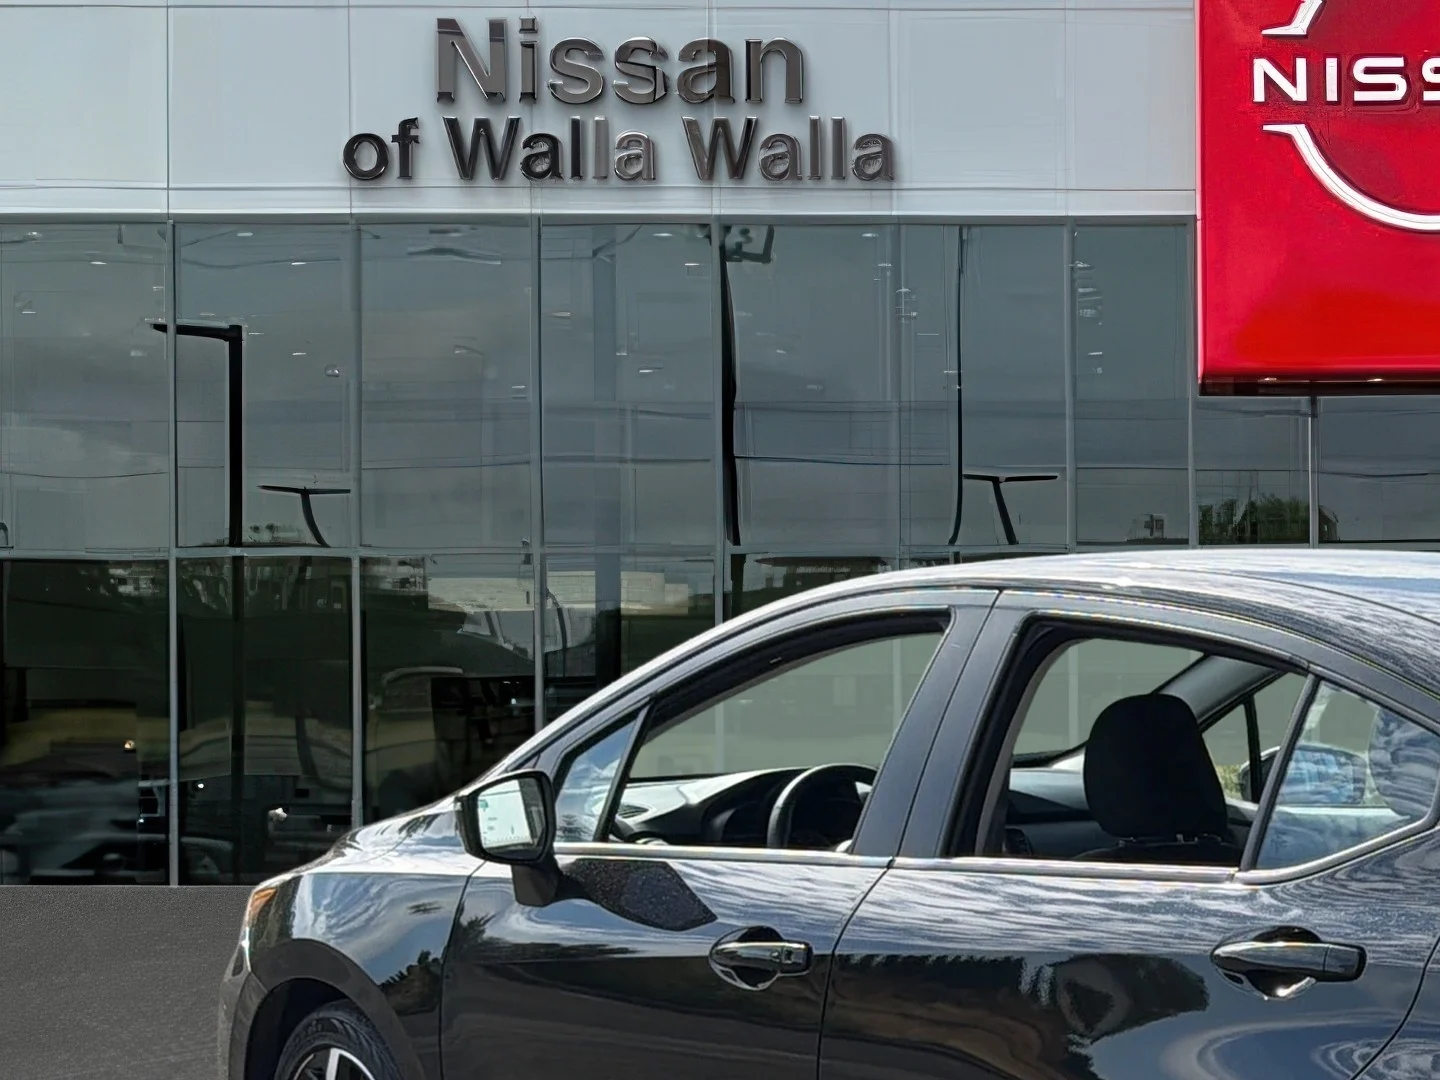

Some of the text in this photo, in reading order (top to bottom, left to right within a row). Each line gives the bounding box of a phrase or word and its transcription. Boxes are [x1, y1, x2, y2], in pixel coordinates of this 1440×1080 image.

[435, 16, 806, 104] Nissan
[342, 115, 895, 182] of Walla Walla
